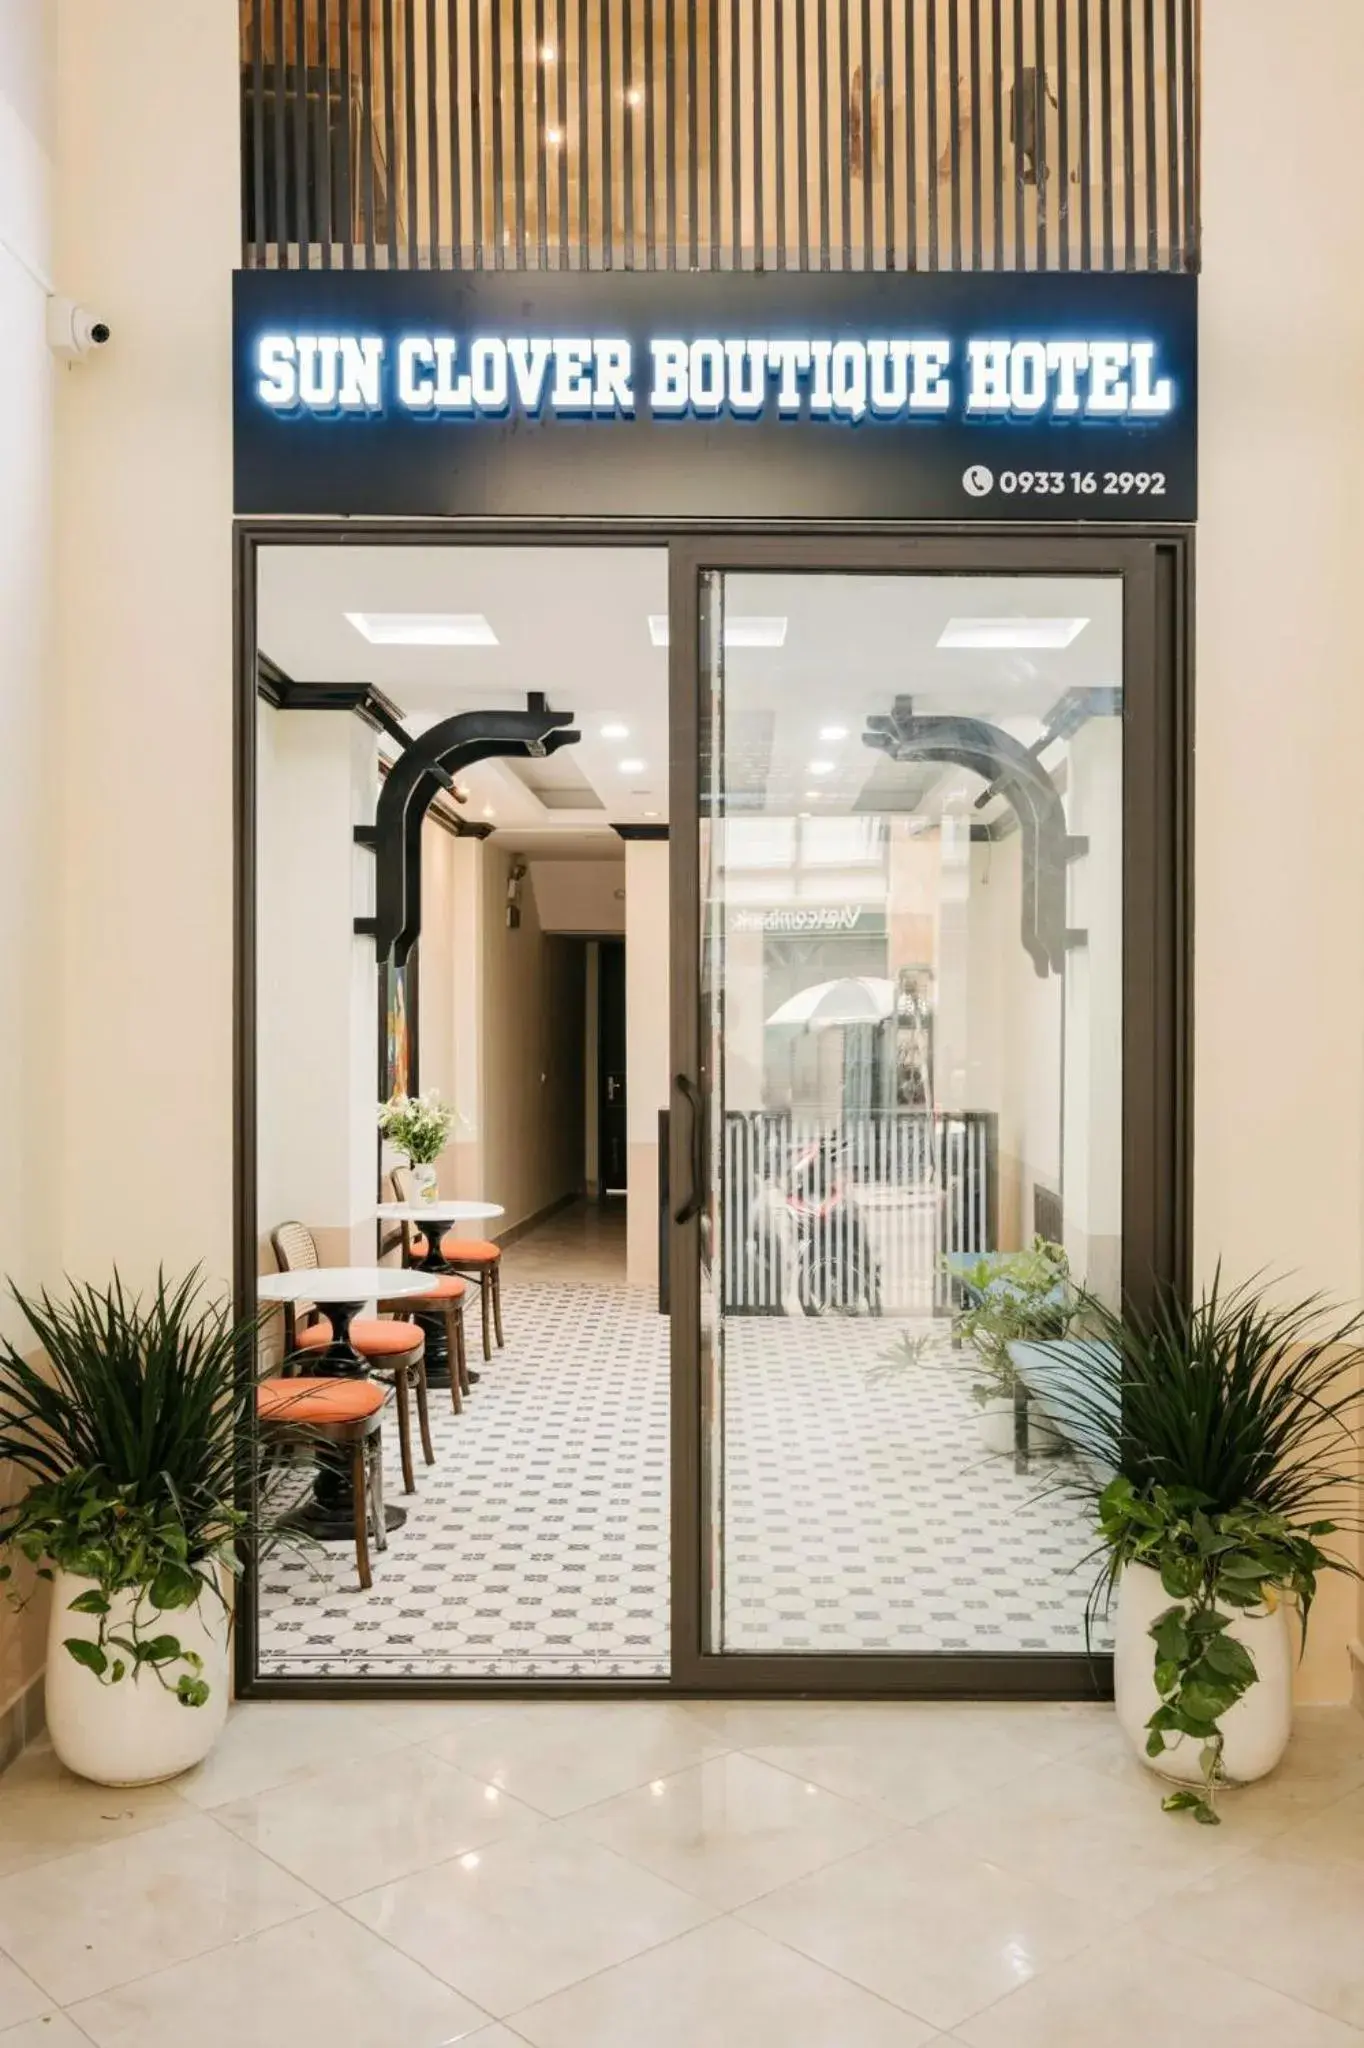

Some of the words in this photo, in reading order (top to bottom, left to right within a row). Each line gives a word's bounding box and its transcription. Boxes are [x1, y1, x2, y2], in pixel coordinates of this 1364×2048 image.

[257, 335, 384, 409] SUN
[399, 336, 635, 410] CLOVER
[650, 339, 950, 417] BOUTIQUE
[966, 340, 1172, 413] HOTEL
[999, 470, 1066, 495] 0933
[1070, 471, 1098, 495] 16
[1103, 471, 1167, 495] 2992
